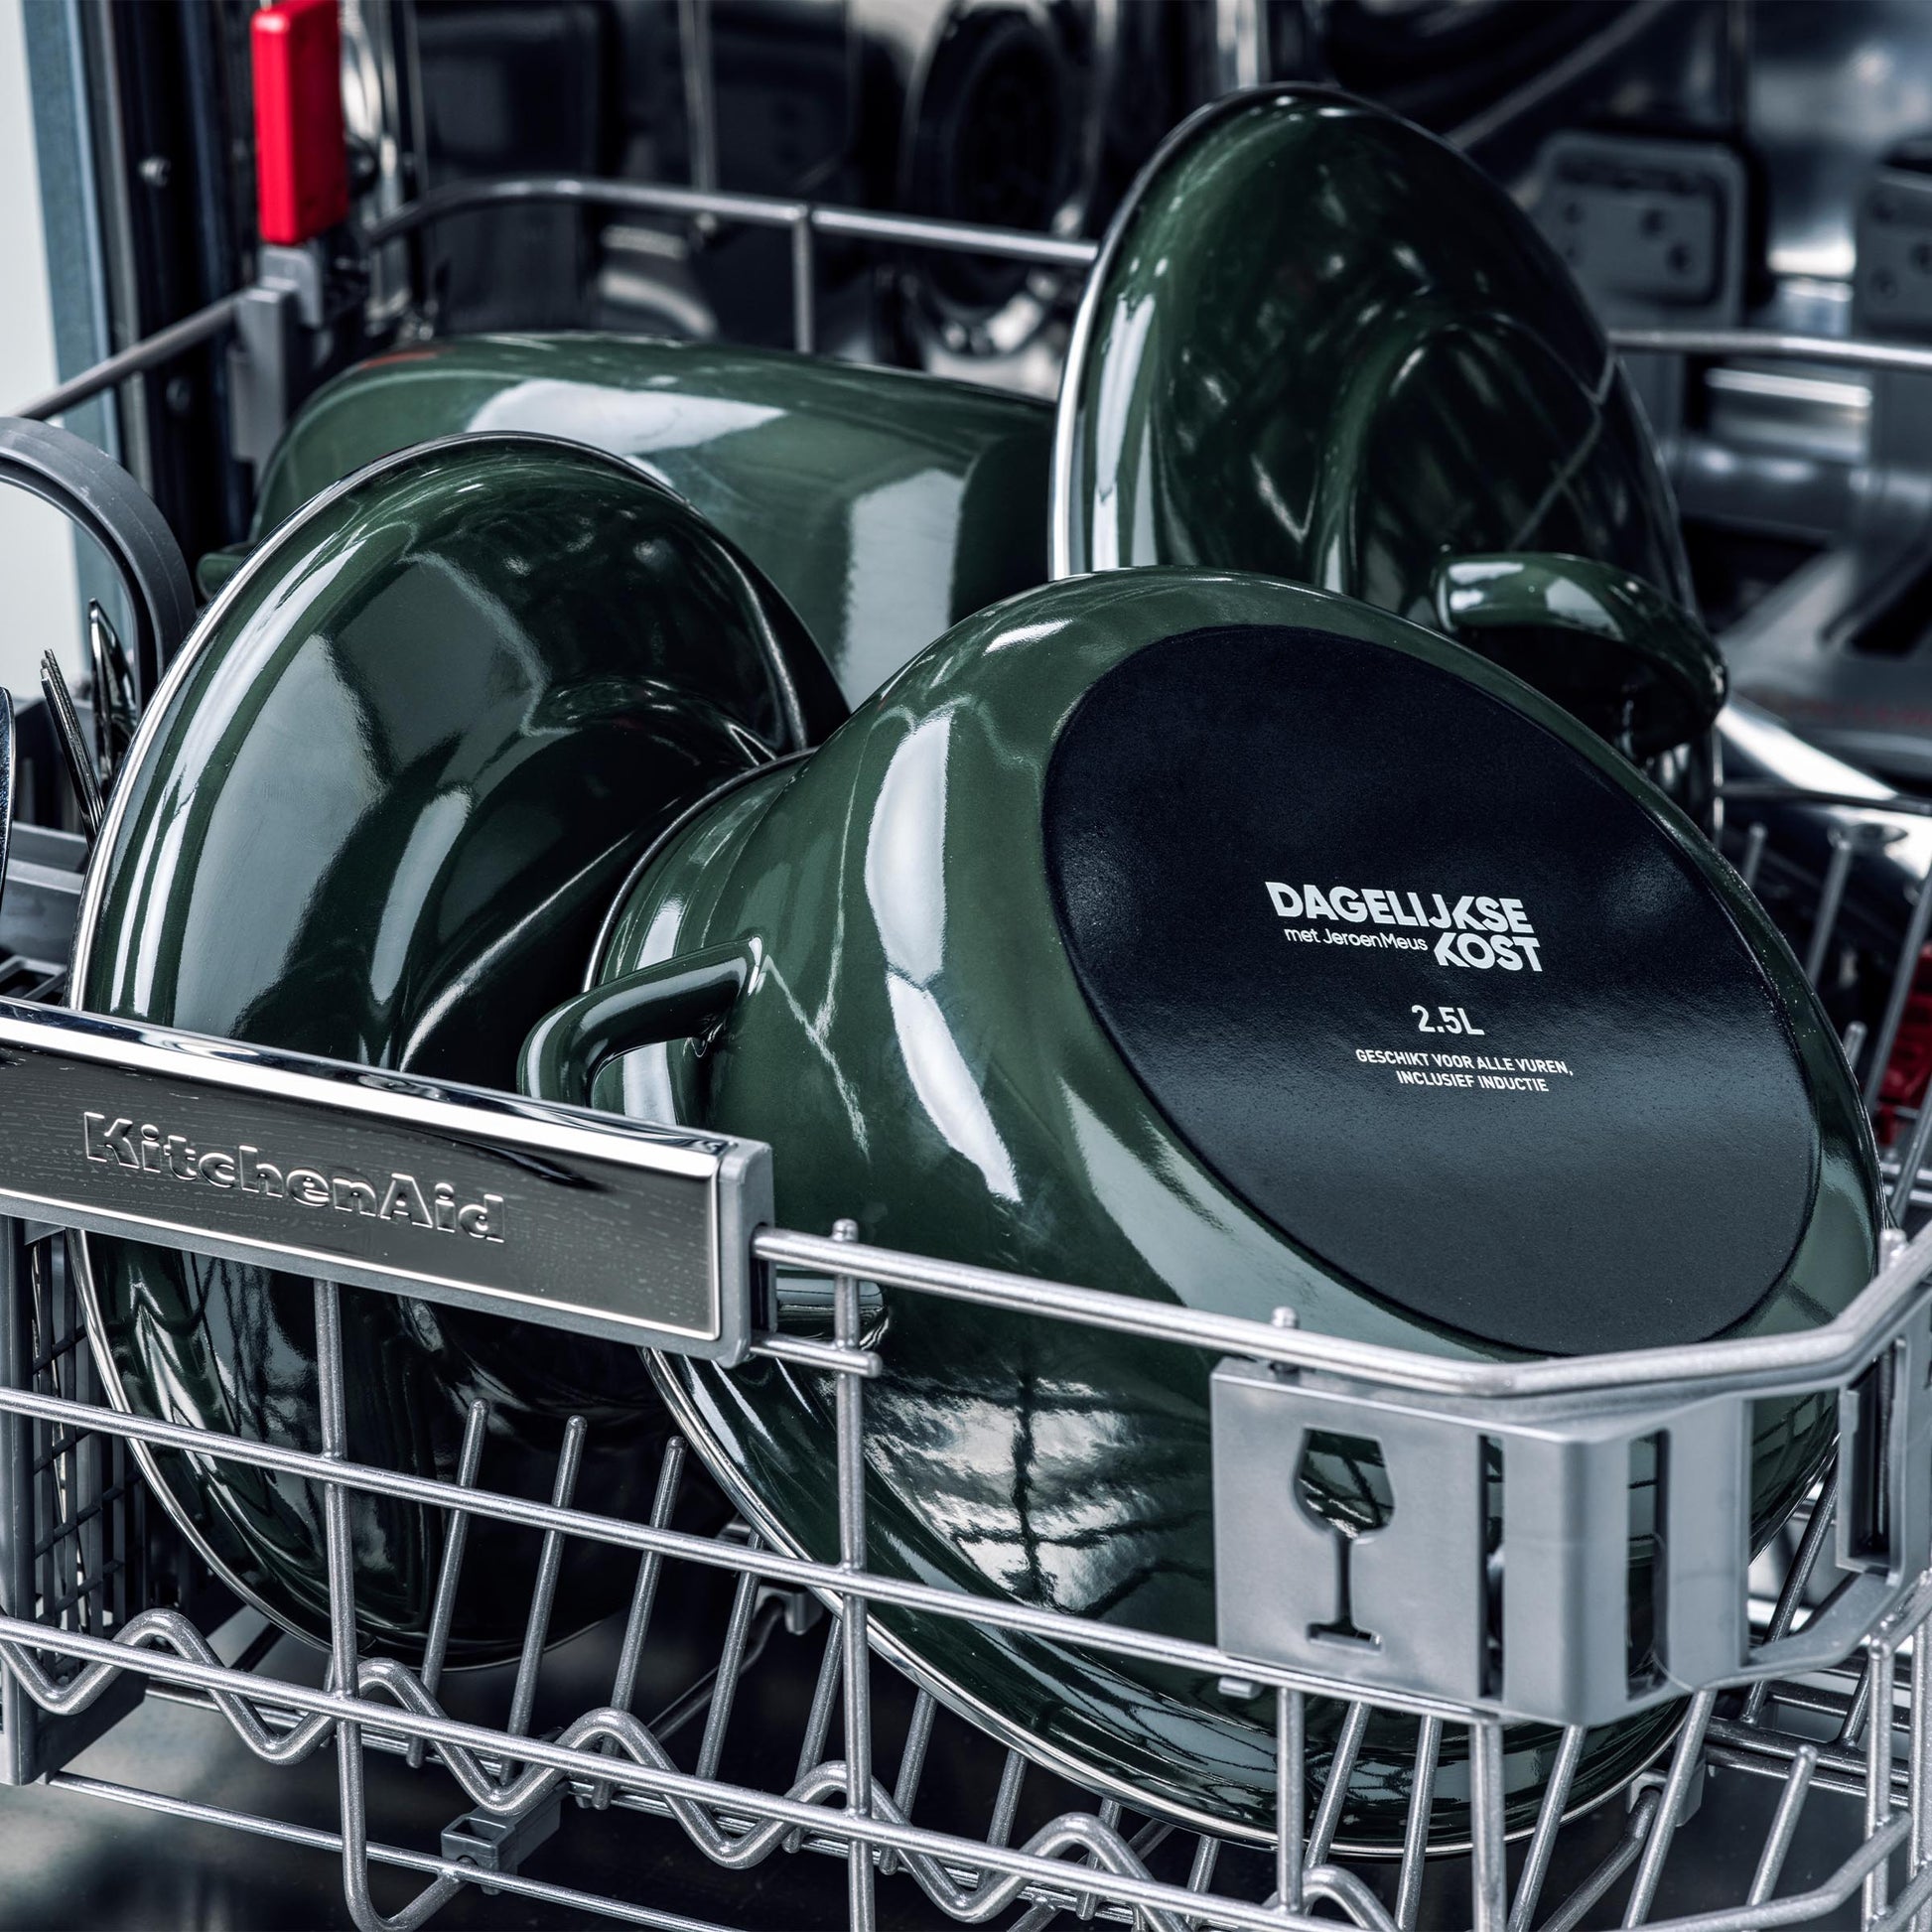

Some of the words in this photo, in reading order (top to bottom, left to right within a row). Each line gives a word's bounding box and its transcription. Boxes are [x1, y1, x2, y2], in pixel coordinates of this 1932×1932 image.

[1265, 881, 1535, 934] DAGELIJKSE
[1284, 928, 1321, 943] met
[1433, 931, 1543, 972] KOST
[1411, 1004, 1485, 1035] 2.5L
[1355, 1048, 1430, 1066] GESCHIKT
[1430, 1052, 1476, 1069] VOOR
[1476, 1055, 1516, 1071] ALLE
[1514, 1057, 1575, 1077] VUREN,
[1395, 1069, 1475, 1088] INCLUSIEF
[1476, 1074, 1550, 1092] INDUCTIE
[83, 1111, 504, 1243] KitchenAid
